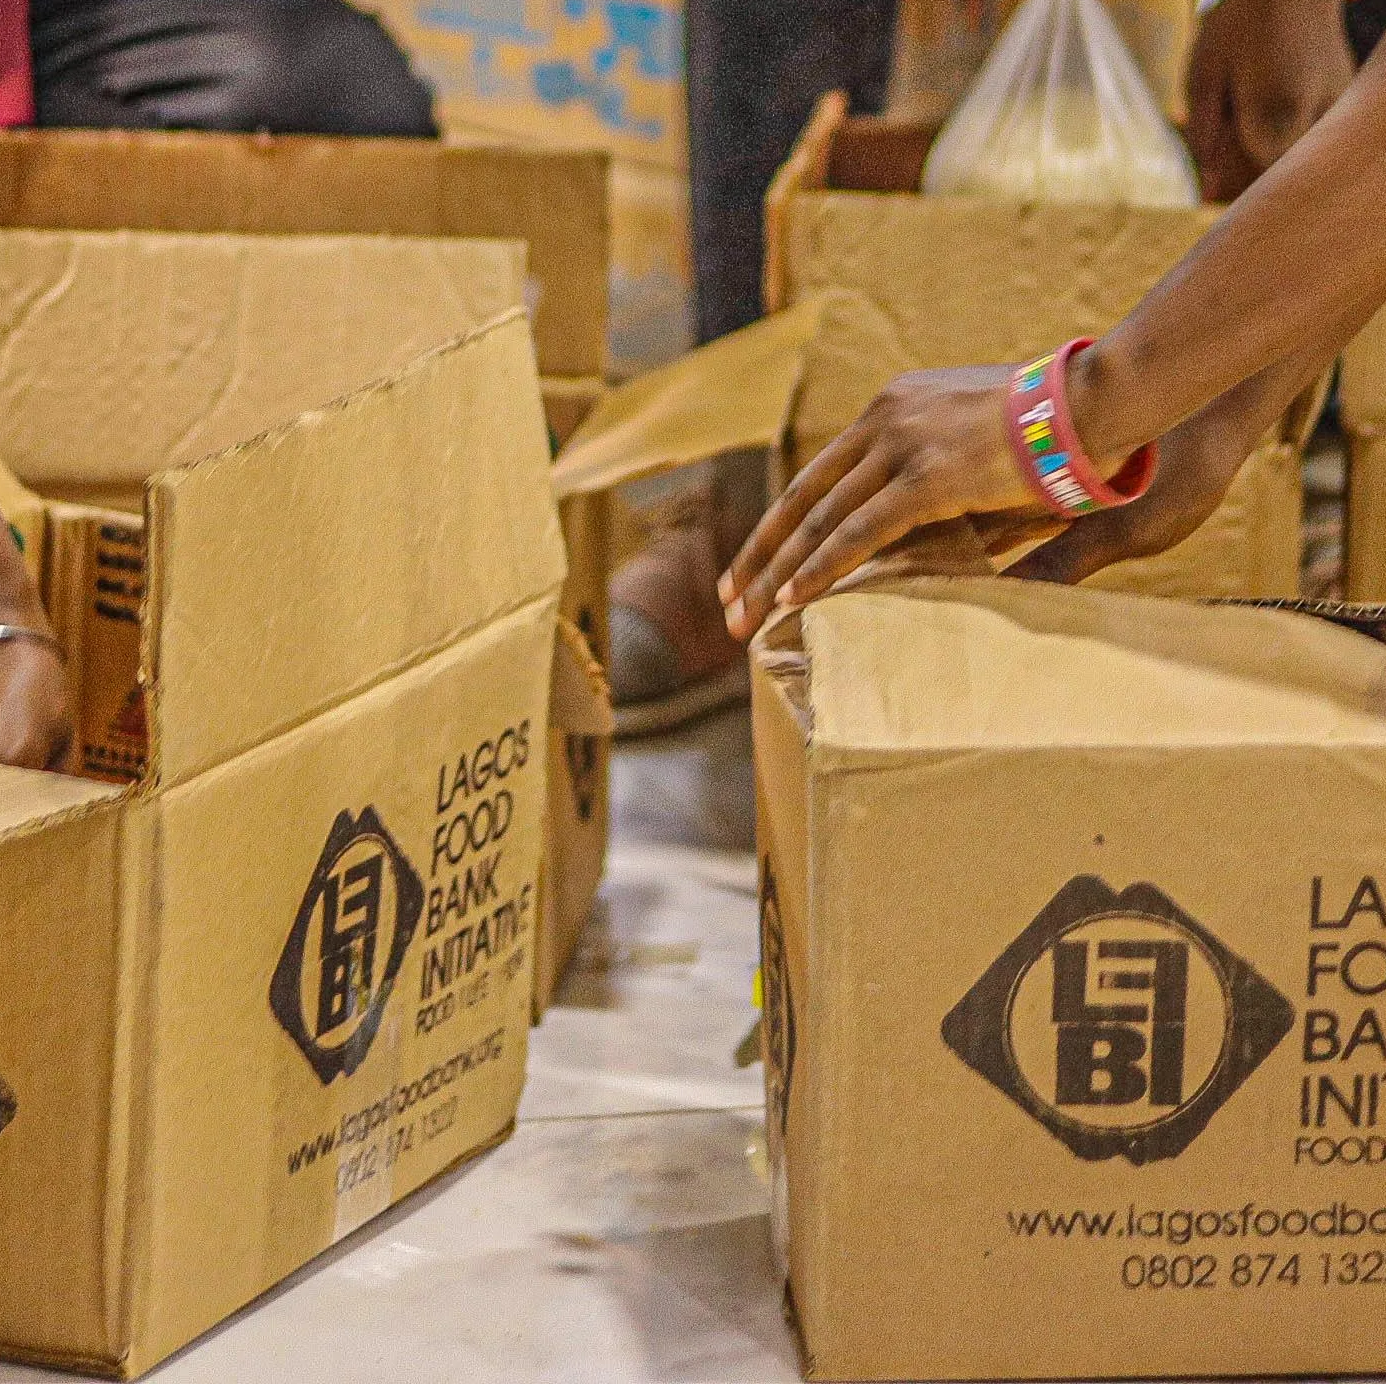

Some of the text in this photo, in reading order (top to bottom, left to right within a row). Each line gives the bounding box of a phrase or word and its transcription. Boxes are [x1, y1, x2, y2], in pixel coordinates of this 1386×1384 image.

[436, 718, 531, 815] LAGOS
[431, 789, 513, 878] FOOD
[425, 849, 502, 939] BANK
[1120, 1254, 1219, 1290] 0802
[1230, 1253, 1301, 1287] 874
